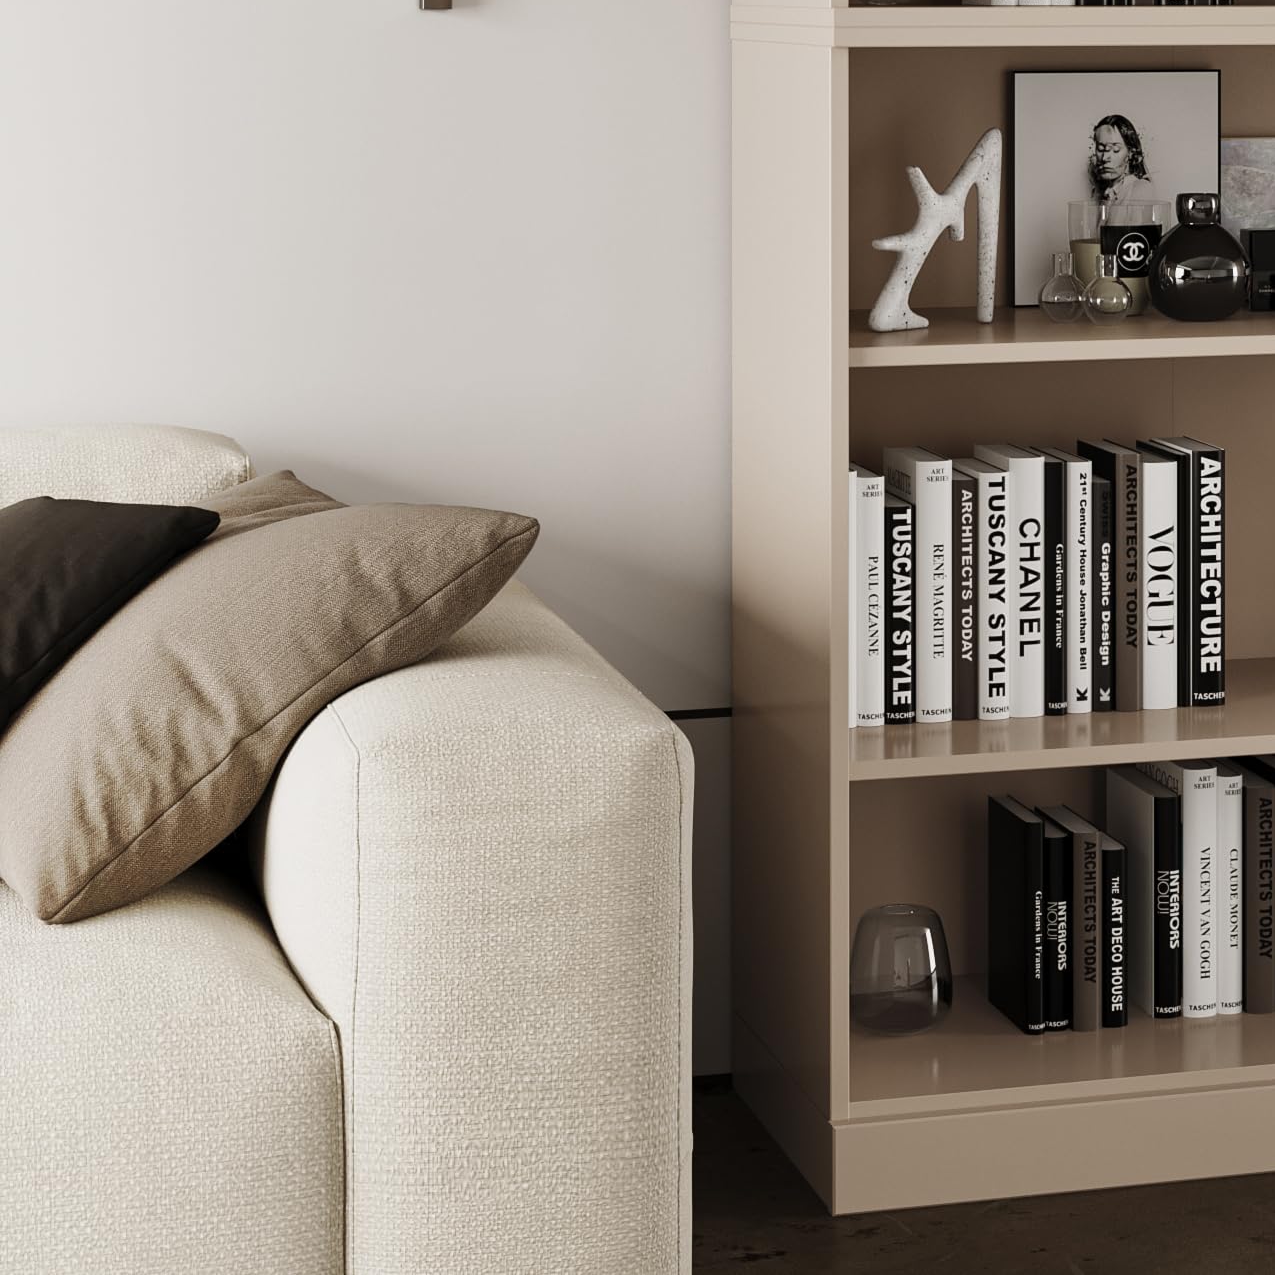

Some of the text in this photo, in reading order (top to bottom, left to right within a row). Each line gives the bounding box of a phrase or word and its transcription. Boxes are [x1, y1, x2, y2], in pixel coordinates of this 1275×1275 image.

[868, 556, 878, 590] PAUL
[892, 509, 912, 623] TUSCANY
[1077, 499, 1088, 546] Century
[1079, 549, 1088, 586] House
[1126, 464, 1137, 648] ARCHITECTS TODAY
[1200, 456, 1221, 673] ARCHITECTURE
[933, 584, 944, 659] MAGRITTE
[961, 489, 973, 661] ARCHITECTS TODAY
[988, 476, 1006, 698] TUSCANY STYLE
[1019, 518, 1041, 658] CHANEL
[1079, 589, 1088, 643] Jonathan
[1146, 525, 1174, 646] VOGUE
[892, 630, 912, 705] STYLE
[1079, 647, 1088, 670] Bell
[1170, 870, 1180, 950] INTERIORS
[1200, 847, 1211, 979] VINCENT VAN GOGH
[1230, 848, 1238, 949] CLAUDE MONET
[1259, 798, 1272, 960] ARCHITECTS TODAY
[1058, 901, 1067, 970] INTERIORS
